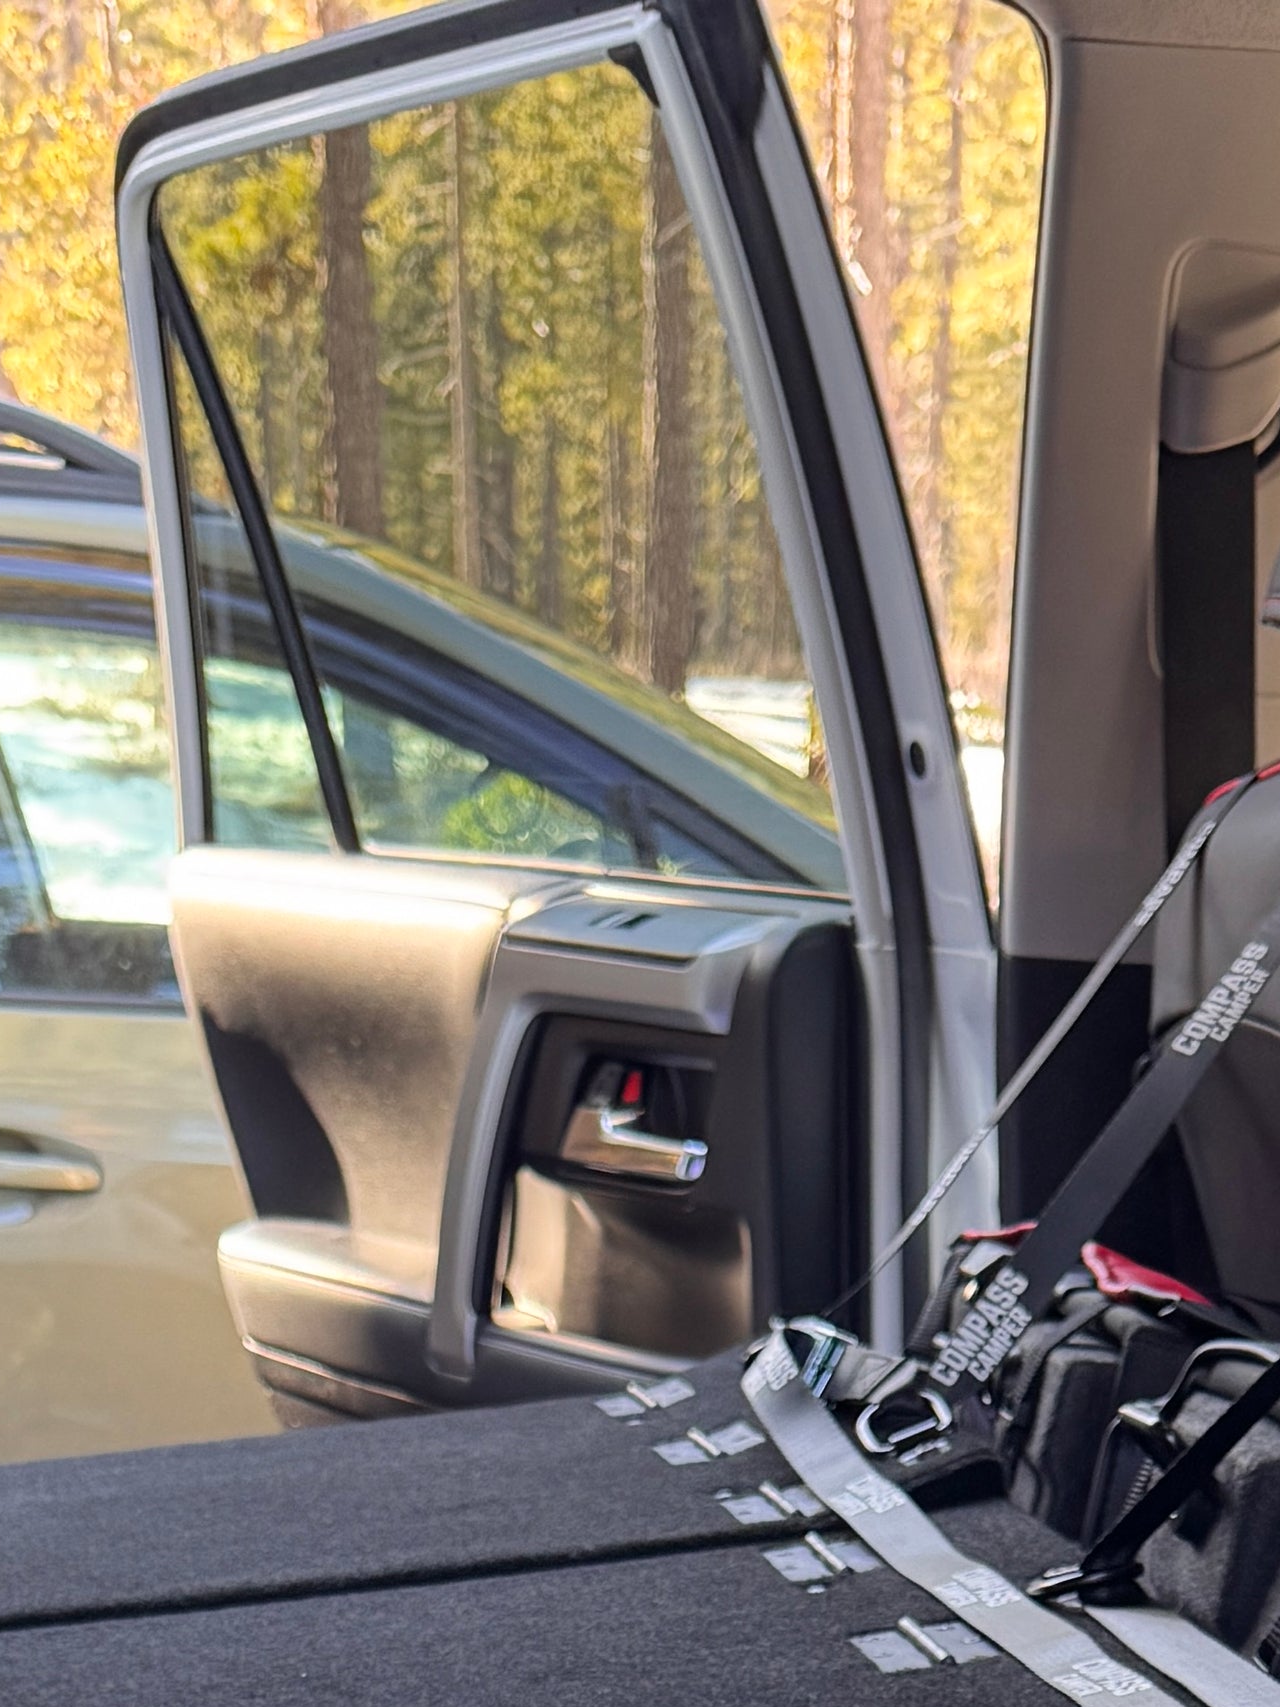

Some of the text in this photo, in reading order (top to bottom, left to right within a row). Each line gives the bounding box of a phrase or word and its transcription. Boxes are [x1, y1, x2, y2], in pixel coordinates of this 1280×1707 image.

[1171, 940, 1270, 1057] COMPASS
[1209, 965, 1271, 1043] CAMPER
[928, 1265, 1030, 1388] COMPASS
[967, 1301, 1033, 1383] CAMPER
